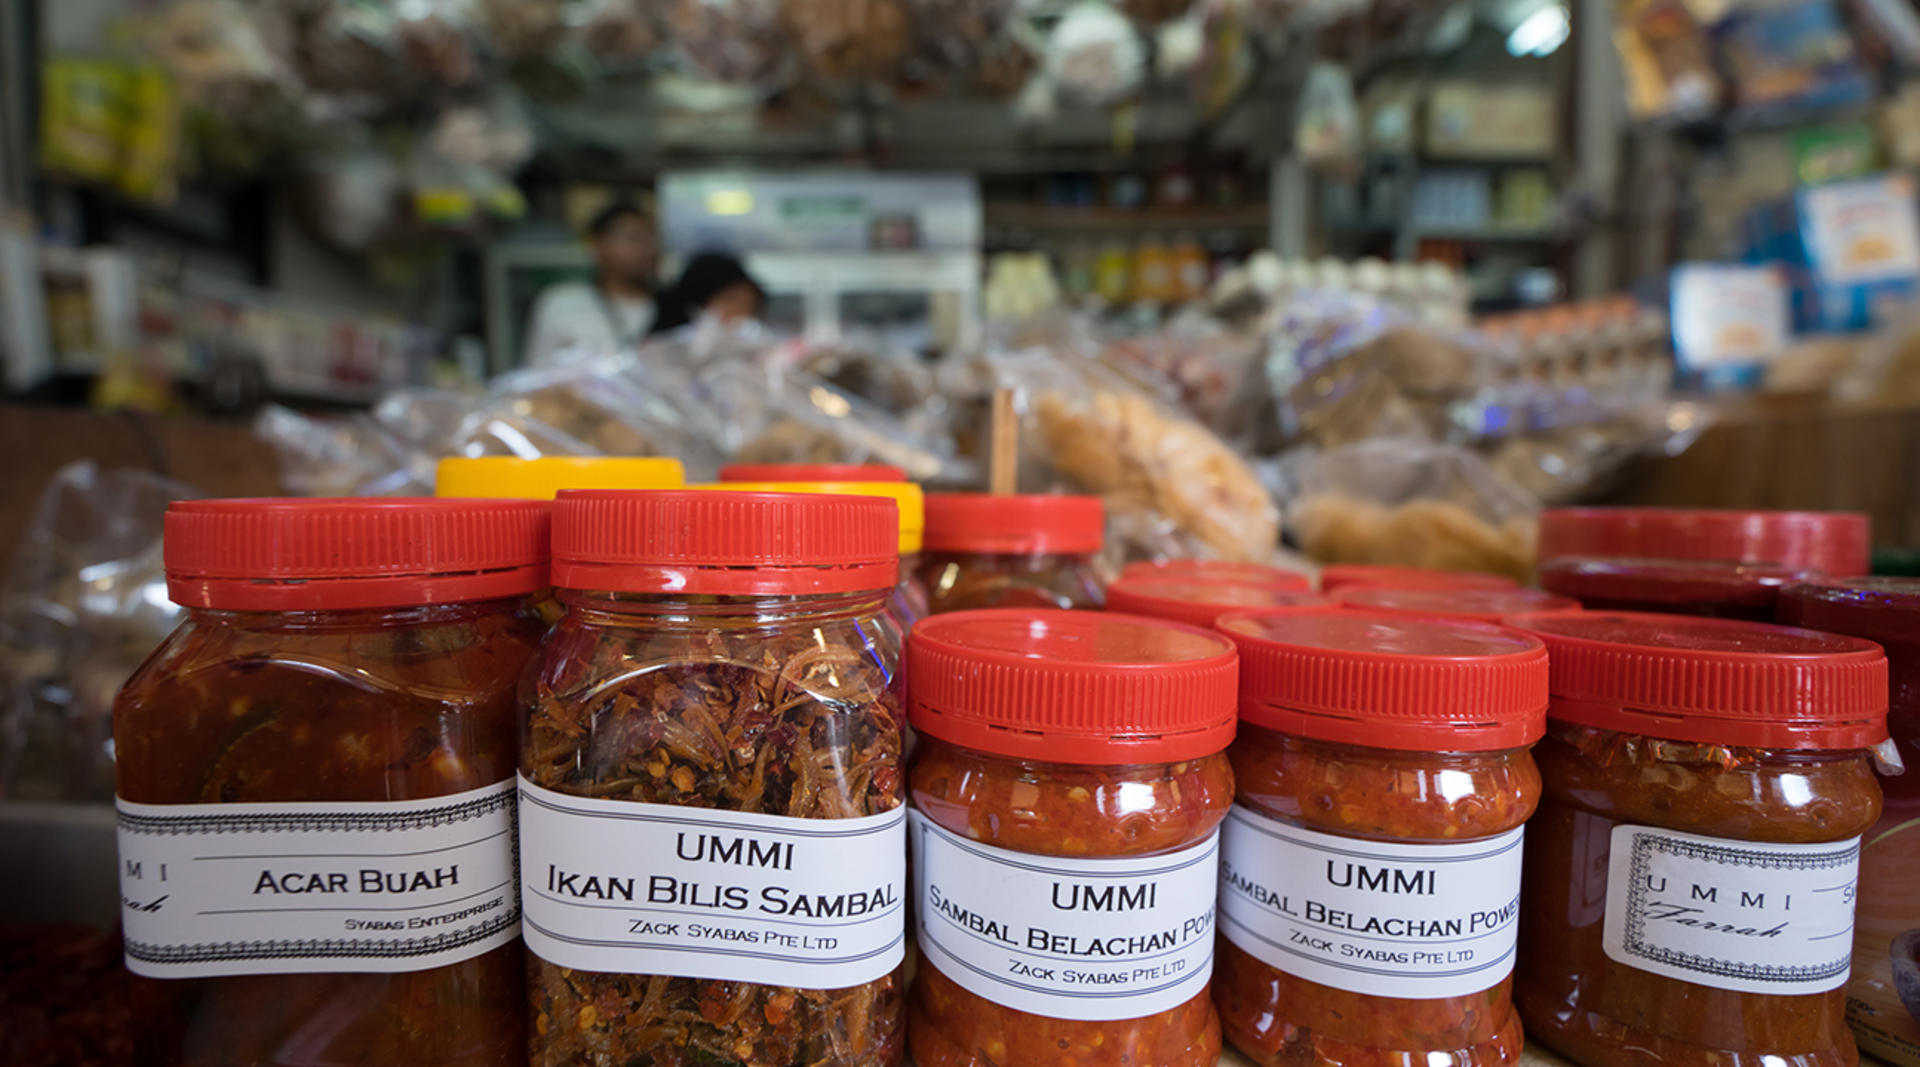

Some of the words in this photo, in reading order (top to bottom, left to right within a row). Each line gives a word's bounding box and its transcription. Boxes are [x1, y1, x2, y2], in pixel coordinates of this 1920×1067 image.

[675, 832, 795, 870] UMMI
[253, 870, 349, 895] ACAR
[359, 865, 460, 894] BUAH
[548, 864, 634, 900] IKAN
[647, 876, 749, 910] BILIS
[760, 883, 898, 918] SAMBAL
[1326, 860, 1436, 895] UMMI
[344, 918, 405, 931] SYABAS
[408, 895, 503, 929] ENTERPRISE
[1050, 882, 1157, 912] UMMI
[1222, 860, 1298, 917] SAMBAL
[1305, 900, 1463, 937] BELACHAN
[628, 919, 679, 937] ZACK
[687, 924, 759, 944] SYABAS
[764, 931, 799, 948] PTE
[803, 936, 838, 950] LTD
[929, 884, 1018, 946] SAMBAL
[1027, 927, 1177, 957] BELACHAN
[1289, 928, 1333, 952] ZACK
[1340, 944, 1408, 964] SYABAS
[1413, 952, 1444, 965] PTE
[1447, 949, 1474, 964] LTD
[1008, 958, 1055, 981] ZACK
[1062, 970, 1128, 985] SYABAS
[1132, 967, 1160, 982] PTE
[1163, 959, 1186, 976] LTD
